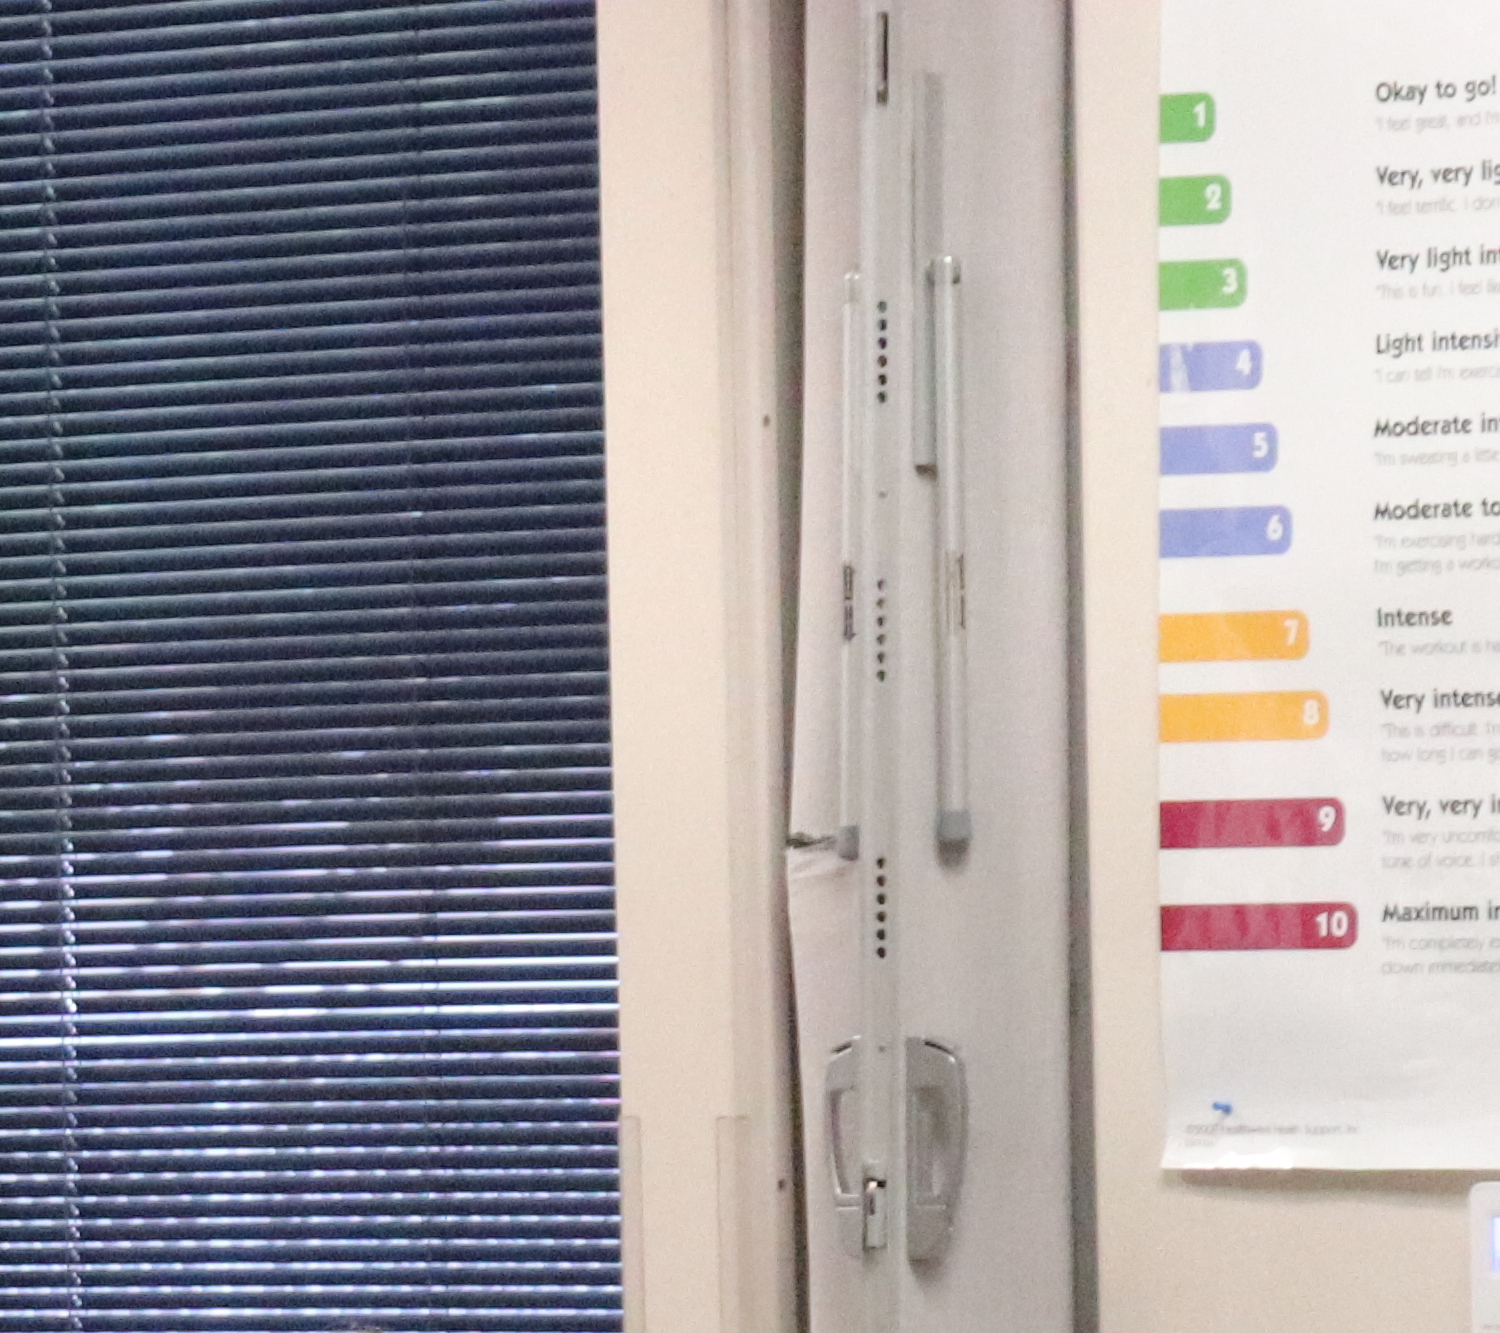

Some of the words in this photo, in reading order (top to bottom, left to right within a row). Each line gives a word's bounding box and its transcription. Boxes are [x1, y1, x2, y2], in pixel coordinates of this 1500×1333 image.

[1375, 82, 1428, 105] Okay
[1435, 80, 1457, 99] to
[1464, 74, 1497, 102] go!
[1193, 101, 1206, 128] 1
[1387, 116, 1411, 132] feel
[1456, 111, 1481, 128] and
[1376, 165, 1423, 189] Very,
[1431, 166, 1473, 186] very
[1205, 182, 1222, 211] 2
[1388, 200, 1411, 216] feel
[1375, 249, 1419, 275] Very
[1427, 245, 1472, 273] light
[1221, 267, 1238, 294] 3
[1457, 281, 1482, 296] feel
[1375, 333, 1424, 359] Light
[1235, 348, 1252, 376] 4
[1386, 371, 1410, 383] can
[1373, 416, 1473, 438] Moderate
[1252, 431, 1269, 459] 5
[1373, 499, 1473, 521] Moderate
[1266, 514, 1284, 542] 6
[1400, 533, 1467, 550] exercising
[1376, 608, 1453, 628] Intense
[1284, 619, 1299, 647] 7
[1411, 640, 1467, 655] workout
[1303, 699, 1320, 726] 8
[1380, 688, 1425, 714] Very
[1381, 749, 1412, 762] how
[1416, 748, 1446, 765] long
[1458, 747, 1484, 760] can
[1318, 805, 1337, 832] 9
[1381, 795, 1431, 820] Very,
[1439, 797, 1483, 819] very
[1381, 901, 1479, 922] Maximum
[1316, 911, 1348, 938] 10
[1409, 936, 1484, 952] completely
[1380, 962, 1424, 975] down
